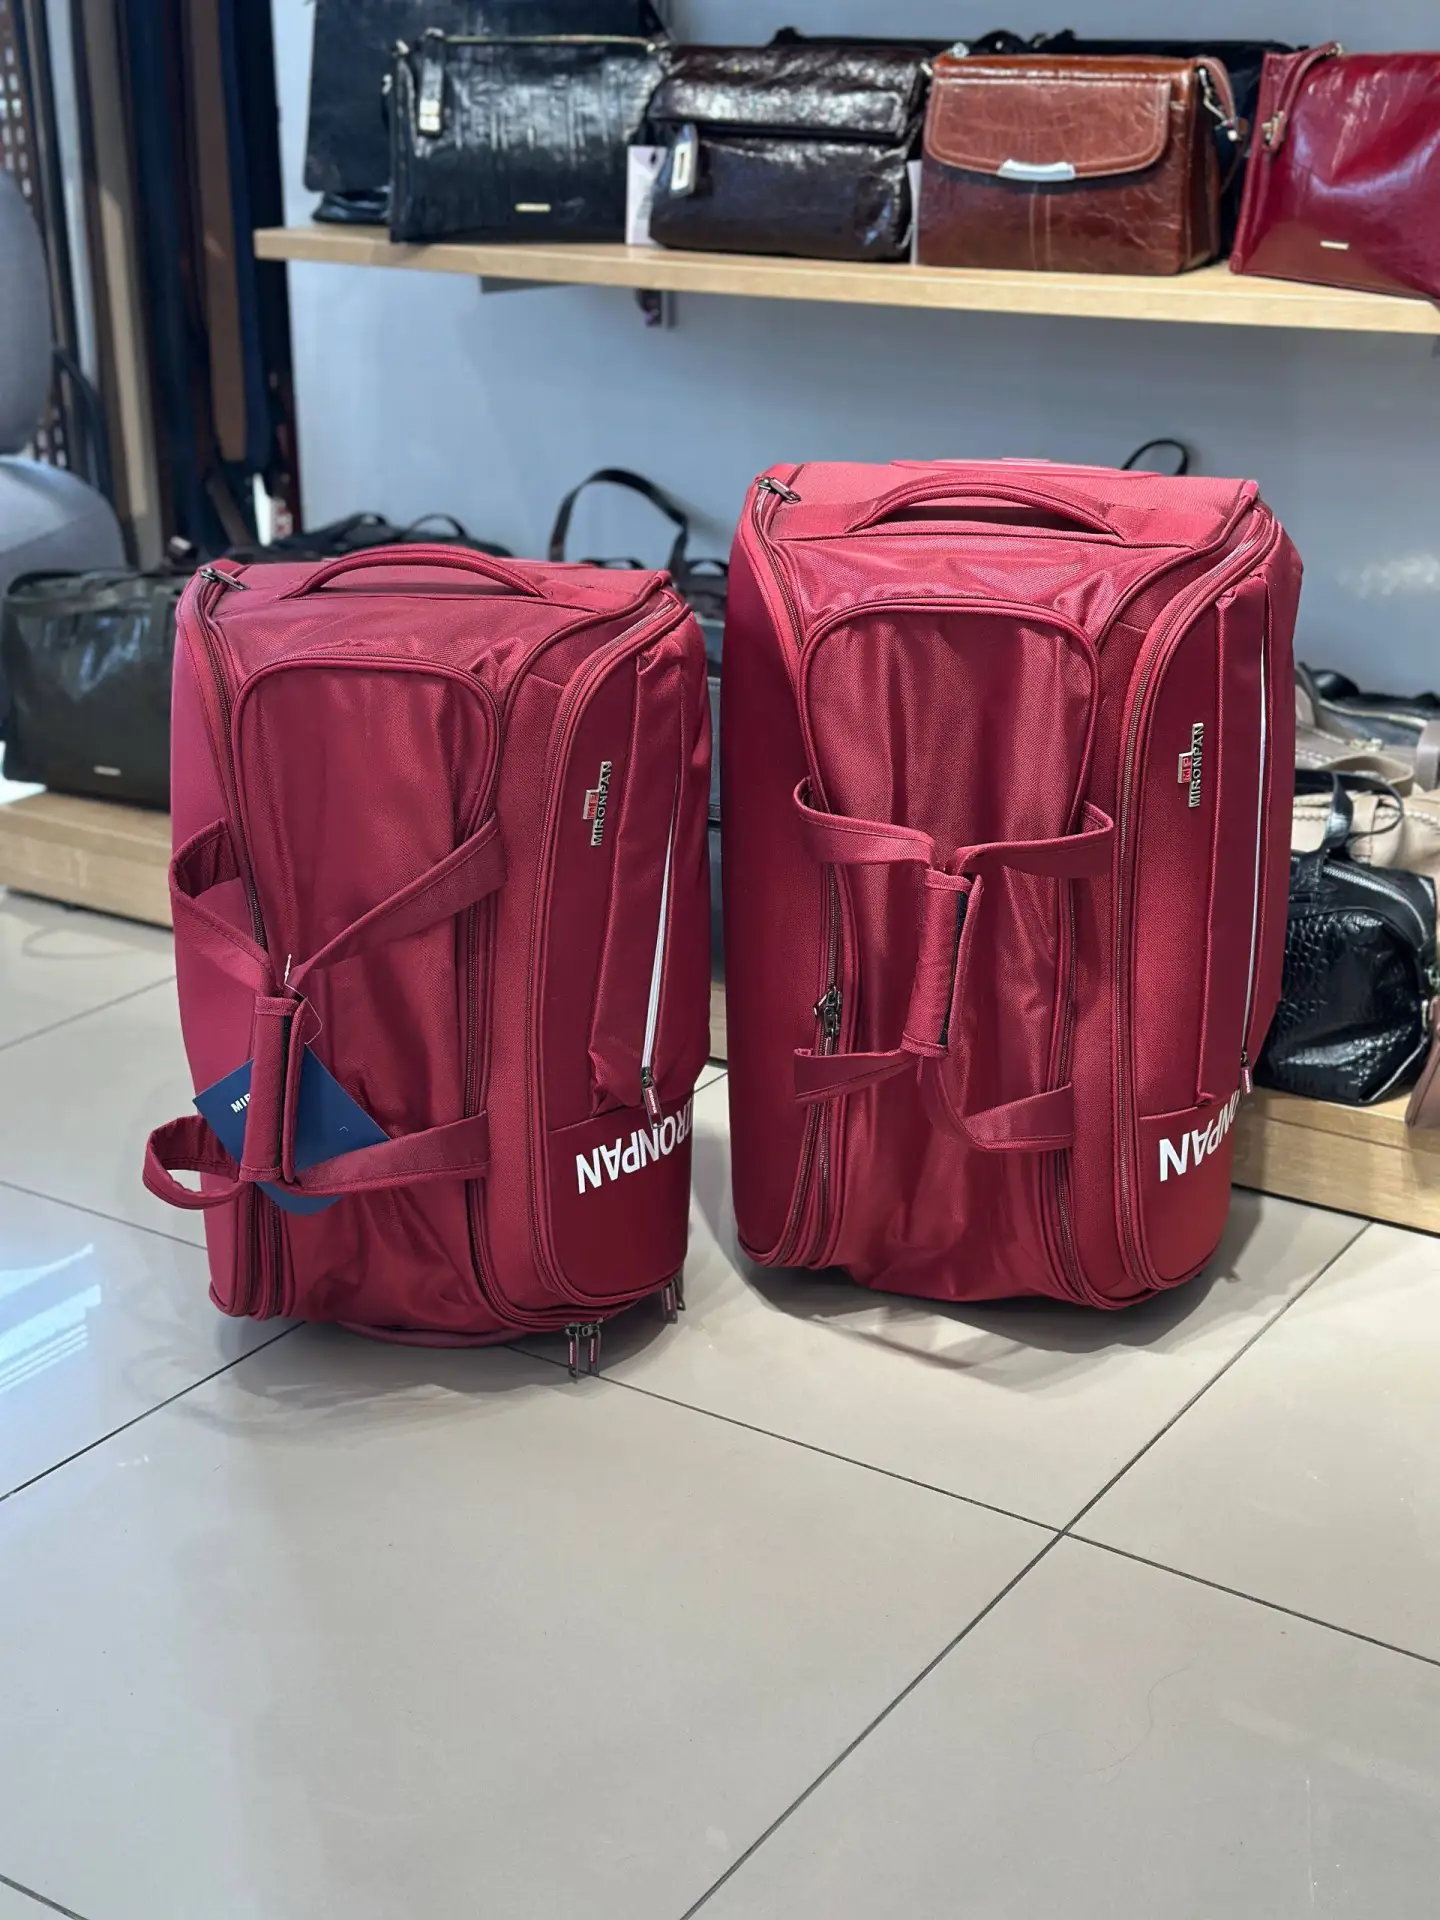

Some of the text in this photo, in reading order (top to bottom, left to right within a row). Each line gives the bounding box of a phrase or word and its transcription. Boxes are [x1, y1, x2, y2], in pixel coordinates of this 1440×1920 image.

[592, 761, 612, 846] MIRONPAN
[1190, 723, 1204, 807] MIRONPAN
[575, 1097, 693, 1194] IRONPAN
